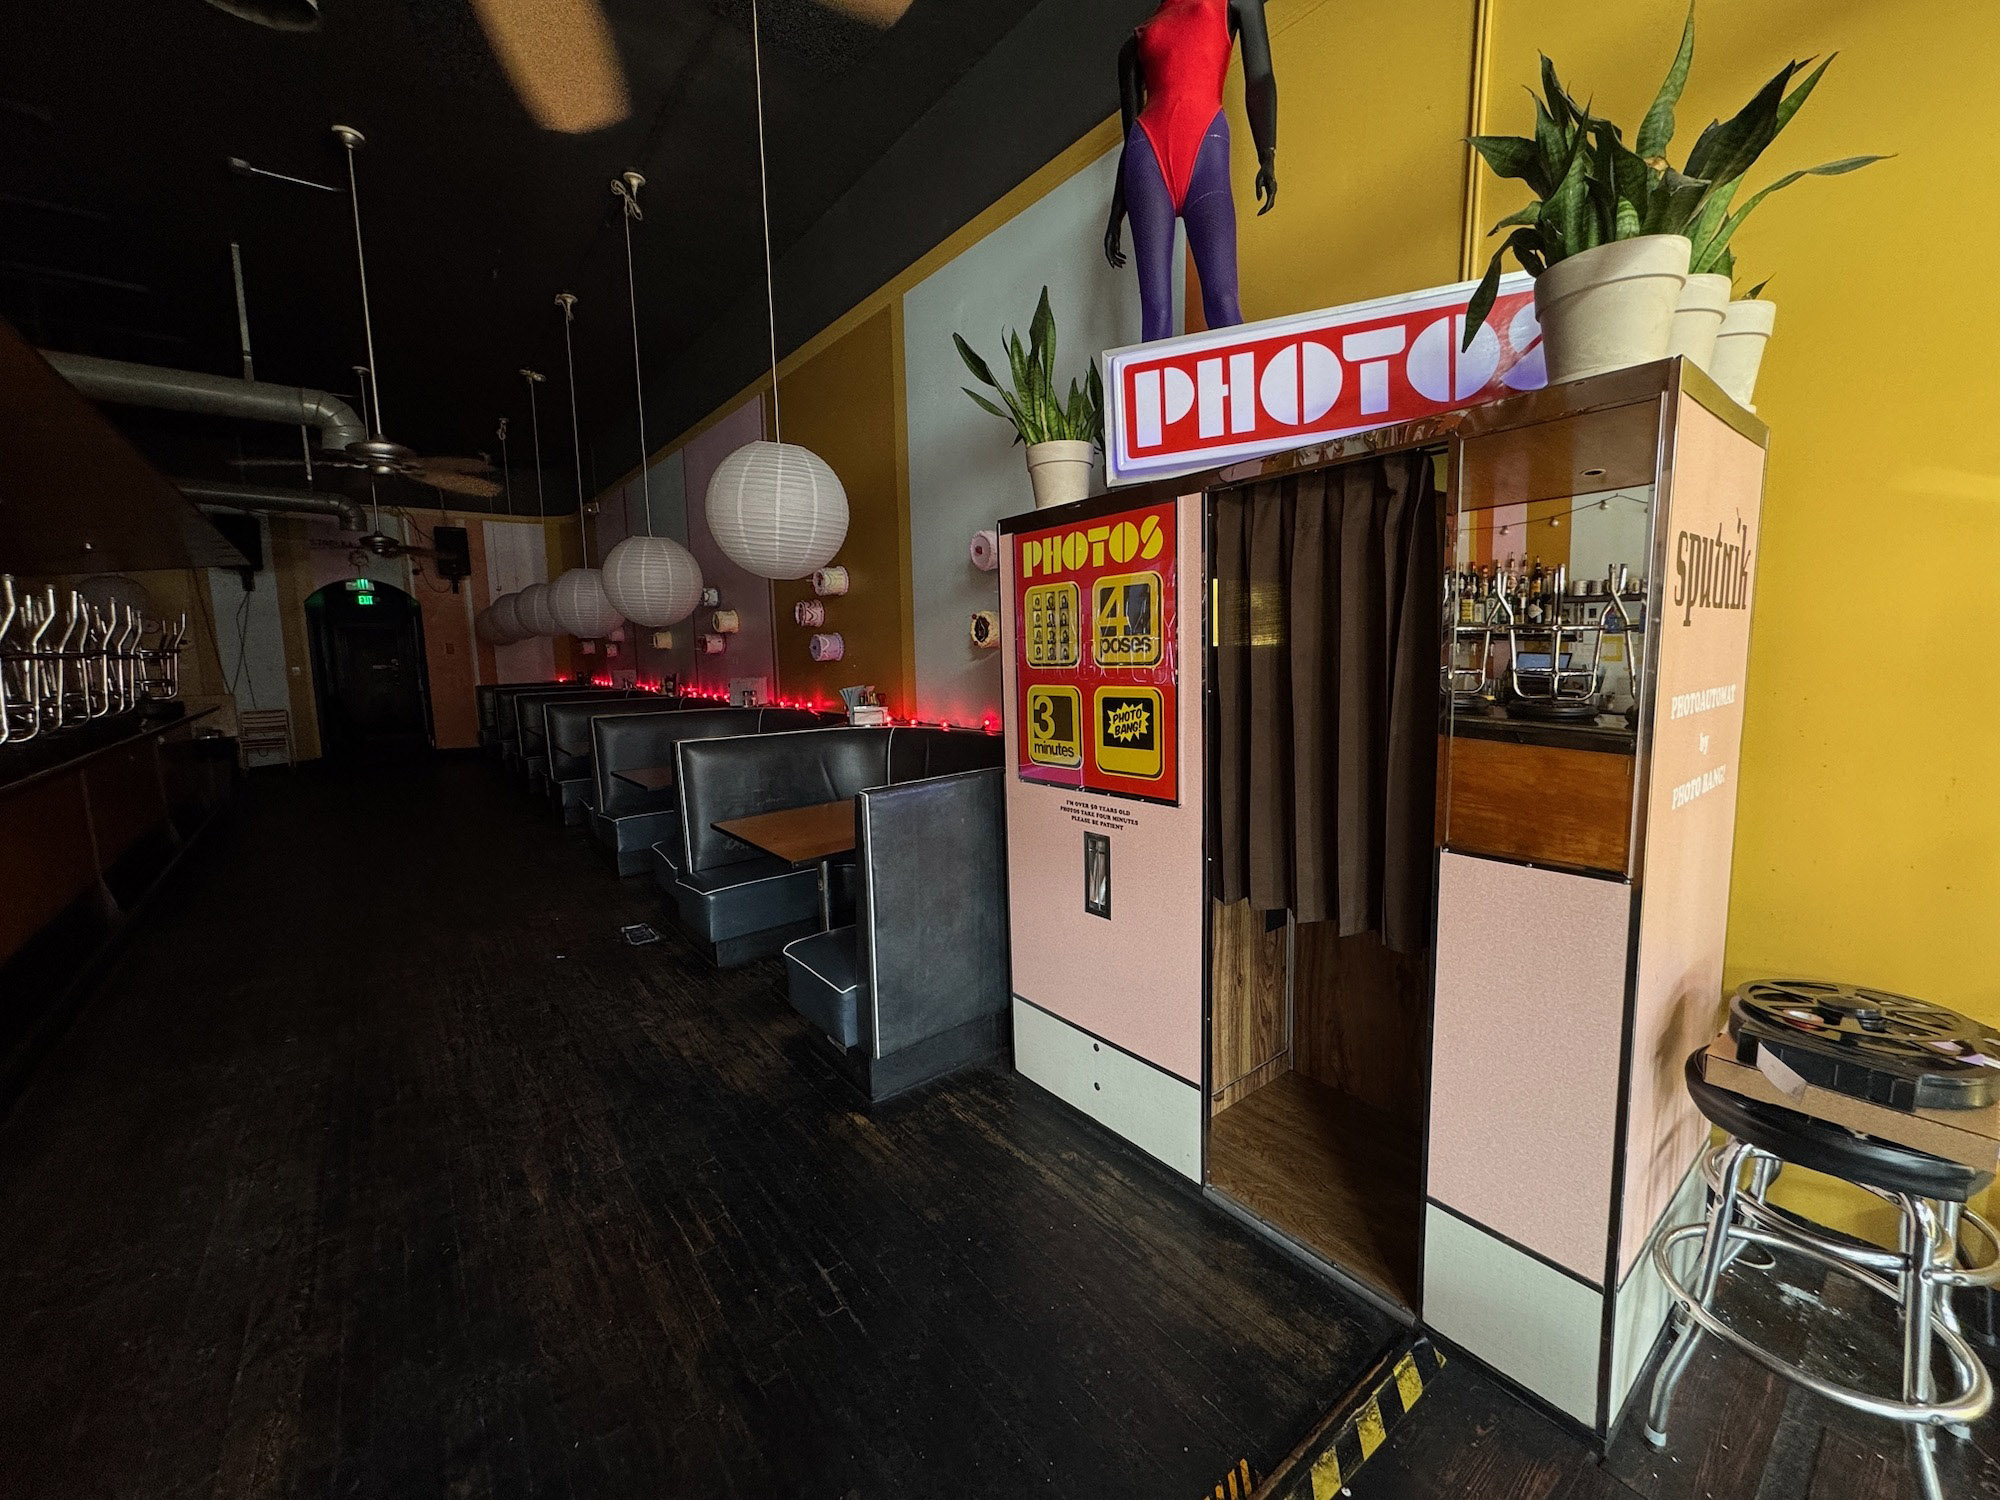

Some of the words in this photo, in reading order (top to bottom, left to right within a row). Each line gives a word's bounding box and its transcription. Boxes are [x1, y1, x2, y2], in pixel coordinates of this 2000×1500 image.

[1023, 515, 1163, 578] PHOTOS
[1674, 507, 1751, 627] sputnik
[1100, 584, 1129, 636] 4
[1101, 636, 1151, 657] poses
[1671, 684, 1736, 720] PHOTOAUTOMAT
[1033, 695, 1056, 741] 3
[1112, 708, 1143, 725] PHOTO
[1114, 719, 1142, 737] BANG!
[1034, 740, 1075, 759] minutes
[1699, 732, 1709, 755] by
[1671, 776, 1701, 810] PHOTO
[1702, 764, 1726, 794] BANG!
[1060, 806, 1080, 814] PHOTOS
[1081, 809, 1095, 818] TAKE
[1112, 816, 1139, 826] MINUTES
[1075, 801, 1089, 809] OVER
[1099, 805, 1117, 814] YEARS
[1071, 815, 1090, 824] PLEASE
[1100, 821, 1124, 830] PATIENT
